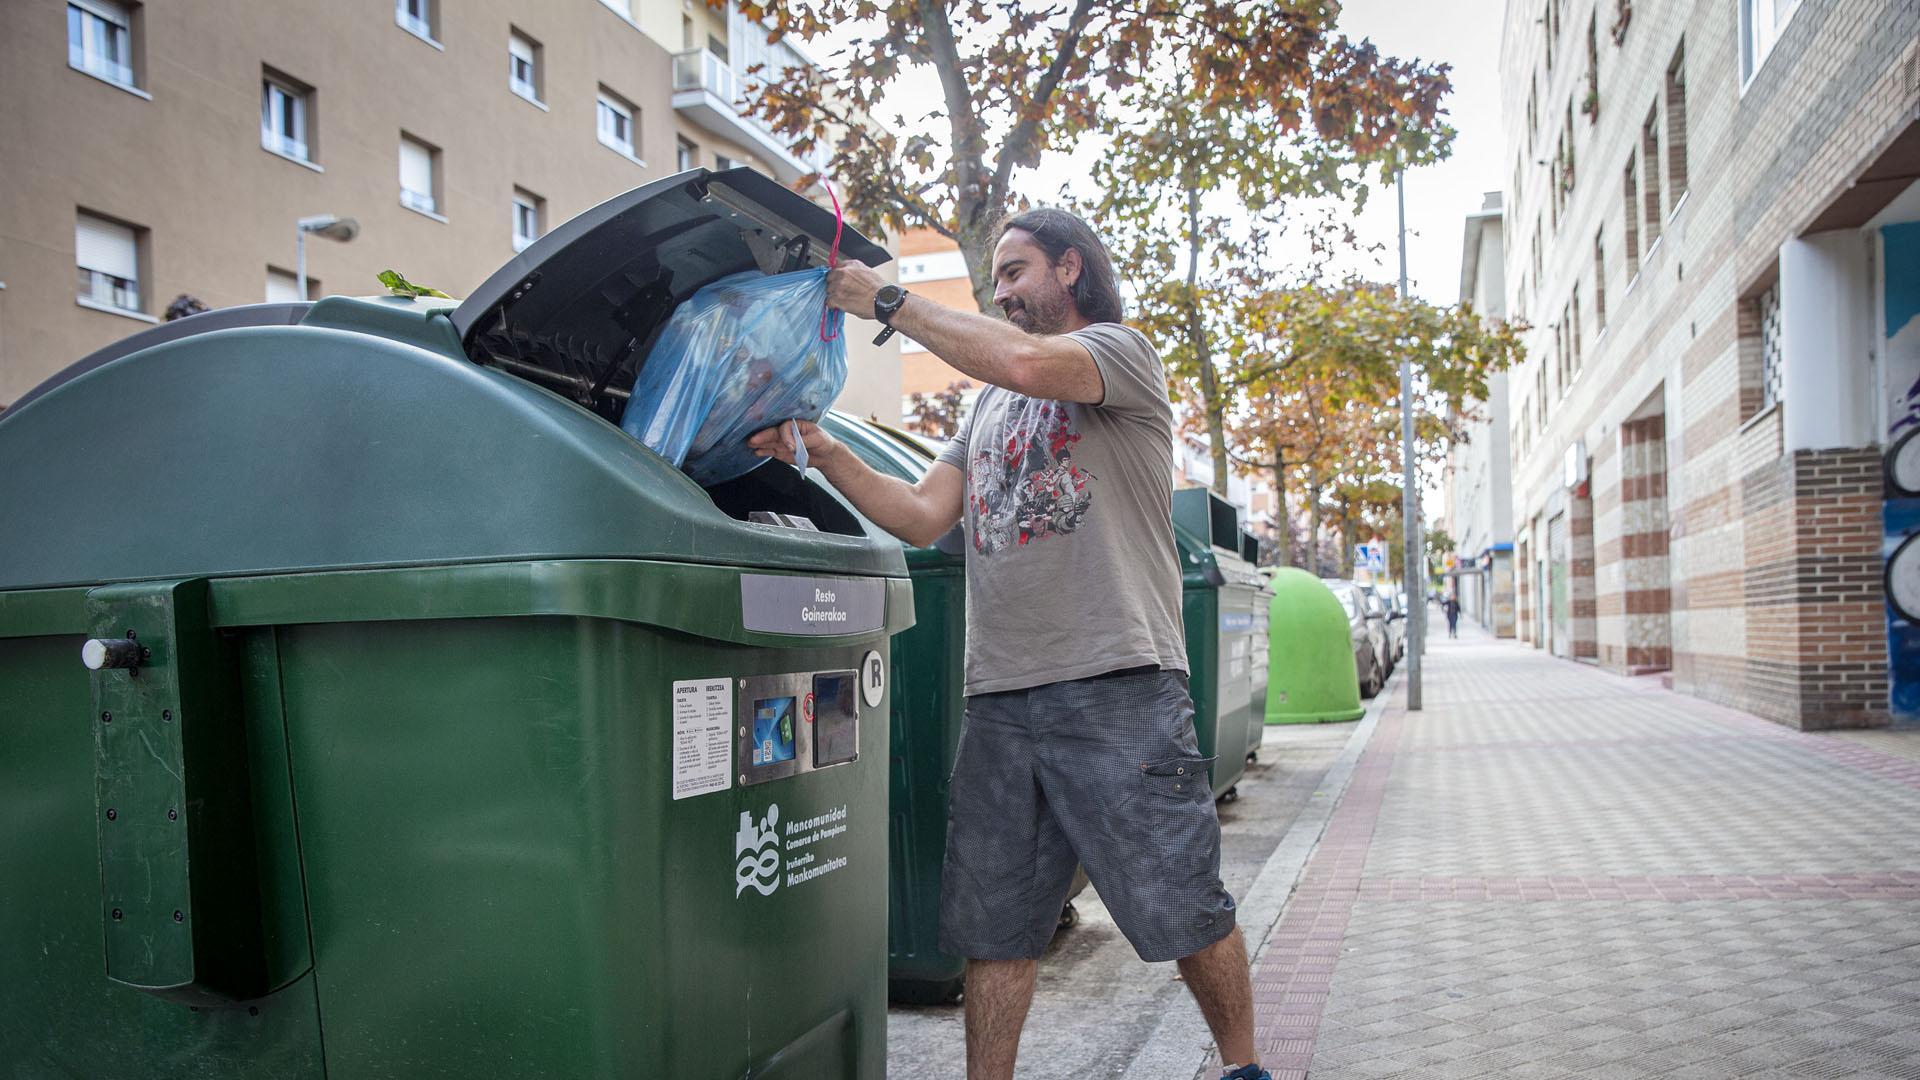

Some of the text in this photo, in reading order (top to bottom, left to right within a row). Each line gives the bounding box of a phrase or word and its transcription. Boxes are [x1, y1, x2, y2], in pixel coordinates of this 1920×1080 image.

[815, 588, 836, 602] Resto
[801, 606, 847, 621] Gainerakoa
[871, 659, 881, 688] R
[677, 686, 698, 694] APERTURA
[706, 684, 725, 692] IREKITZEA
[786, 804, 847, 836] Mancomunidad
[786, 825, 847, 851] Comarca de Pamplona
[786, 857, 847, 887] Mankomunitatea
